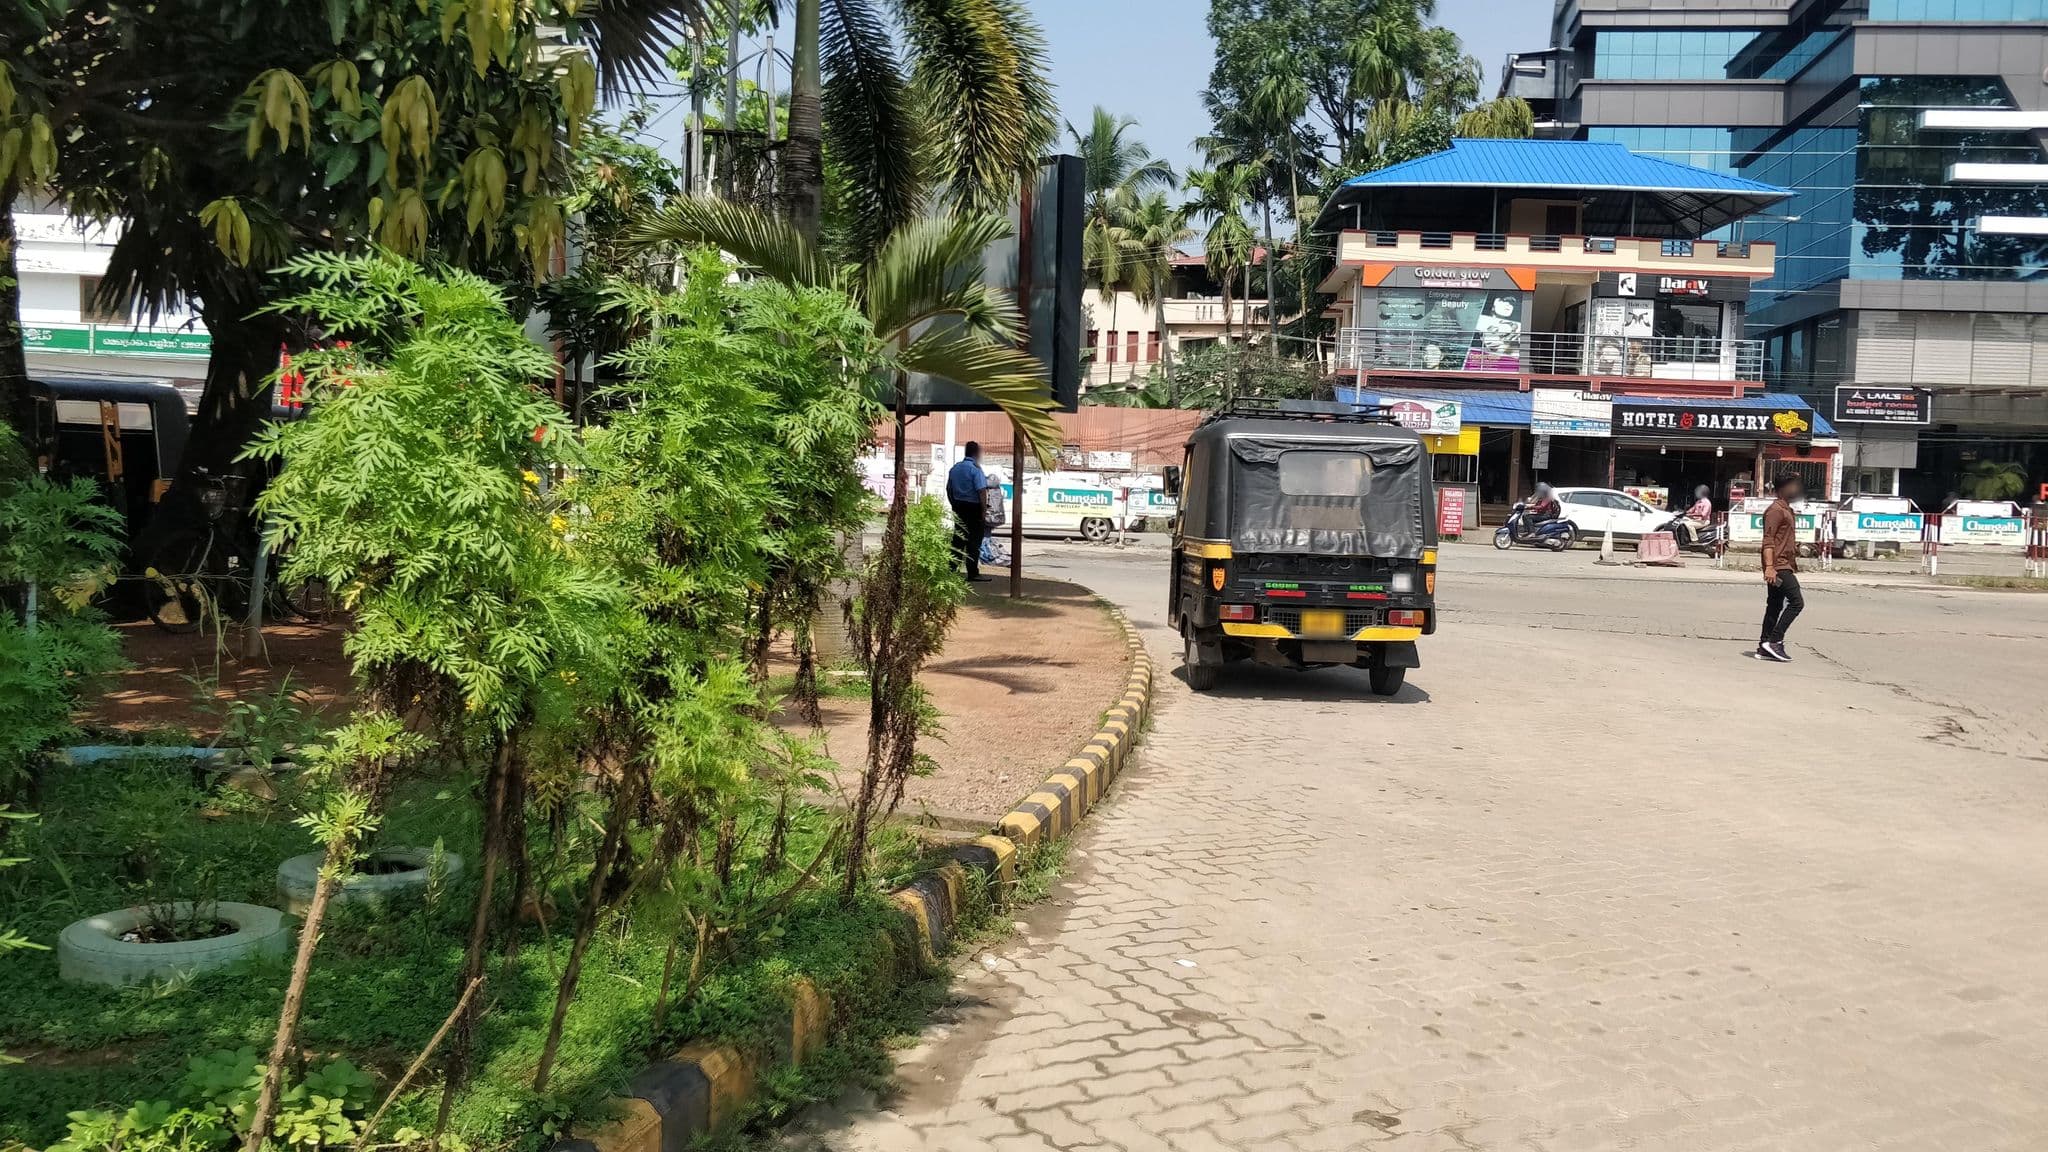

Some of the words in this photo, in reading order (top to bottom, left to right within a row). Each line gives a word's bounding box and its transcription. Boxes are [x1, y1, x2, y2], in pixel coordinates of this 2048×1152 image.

[1414, 267, 1456, 280] Golden
[1460, 270, 1490, 282] glow
[1441, 300, 1469, 310] Beauty
[1847, 400, 1883, 409] budget
[1621, 412, 1677, 428] HOTEL
[1680, 413, 1694, 430] &
[1697, 414, 1770, 431] BAKERY
[1052, 491, 1109, 505] Chungath
[1862, 517, 1918, 532] Chungath
[1966, 521, 2019, 535] Chungath
